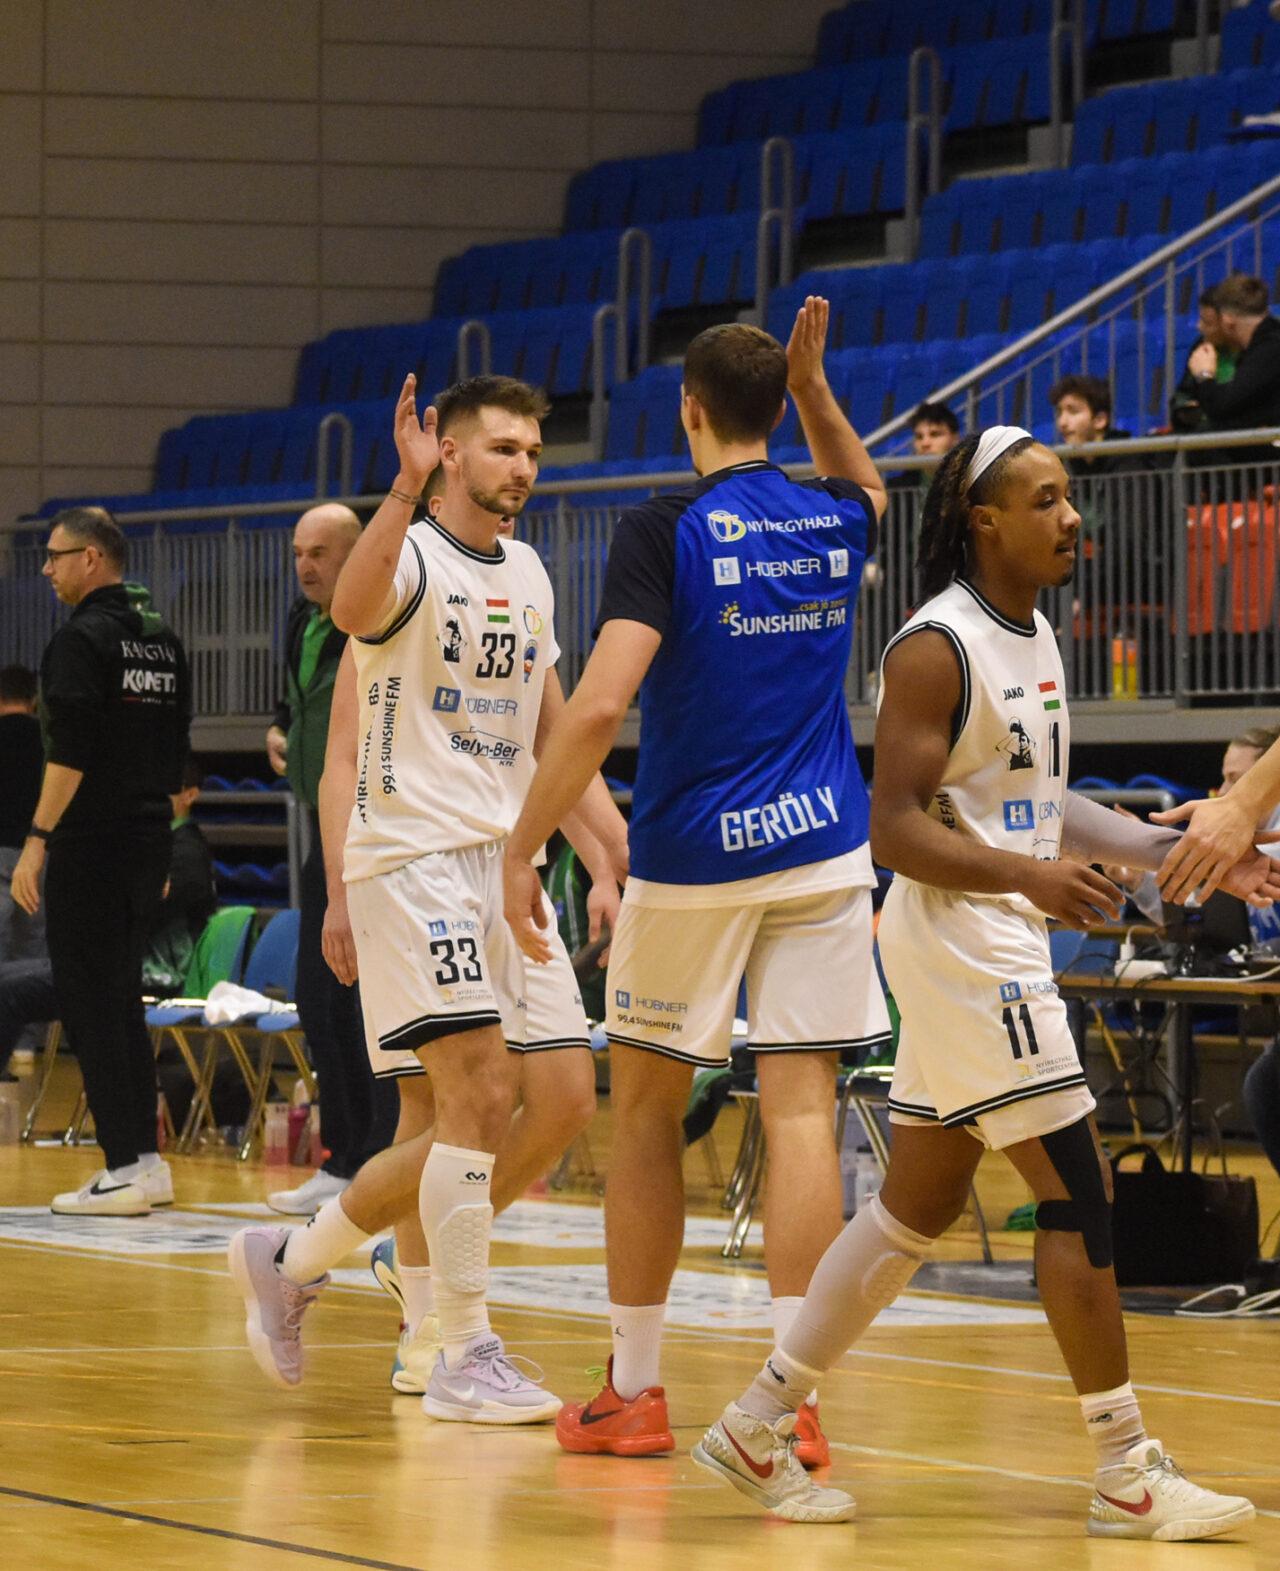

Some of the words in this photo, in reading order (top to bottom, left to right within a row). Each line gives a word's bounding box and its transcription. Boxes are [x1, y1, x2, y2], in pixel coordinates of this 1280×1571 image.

[745, 558, 821, 578] HÜBNER
[729, 613, 822, 637] SUNSHINE
[827, 607, 846, 628] FM
[475, 632, 516, 679] 33
[386, 676, 402, 700] FM
[1003, 687, 1025, 701] JAKO
[465, 697, 518, 717] ÜBNER
[381, 701, 397, 762] SUNSHINE
[381, 764, 397, 795] 99.4
[720, 786, 840, 852] GERÖLY
[429, 937, 483, 986] 33
[635, 996, 688, 1014] HÜBNER
[636, 1016, 671, 1031] SUNSHINE
[1002, 1003, 1039, 1060] 11
